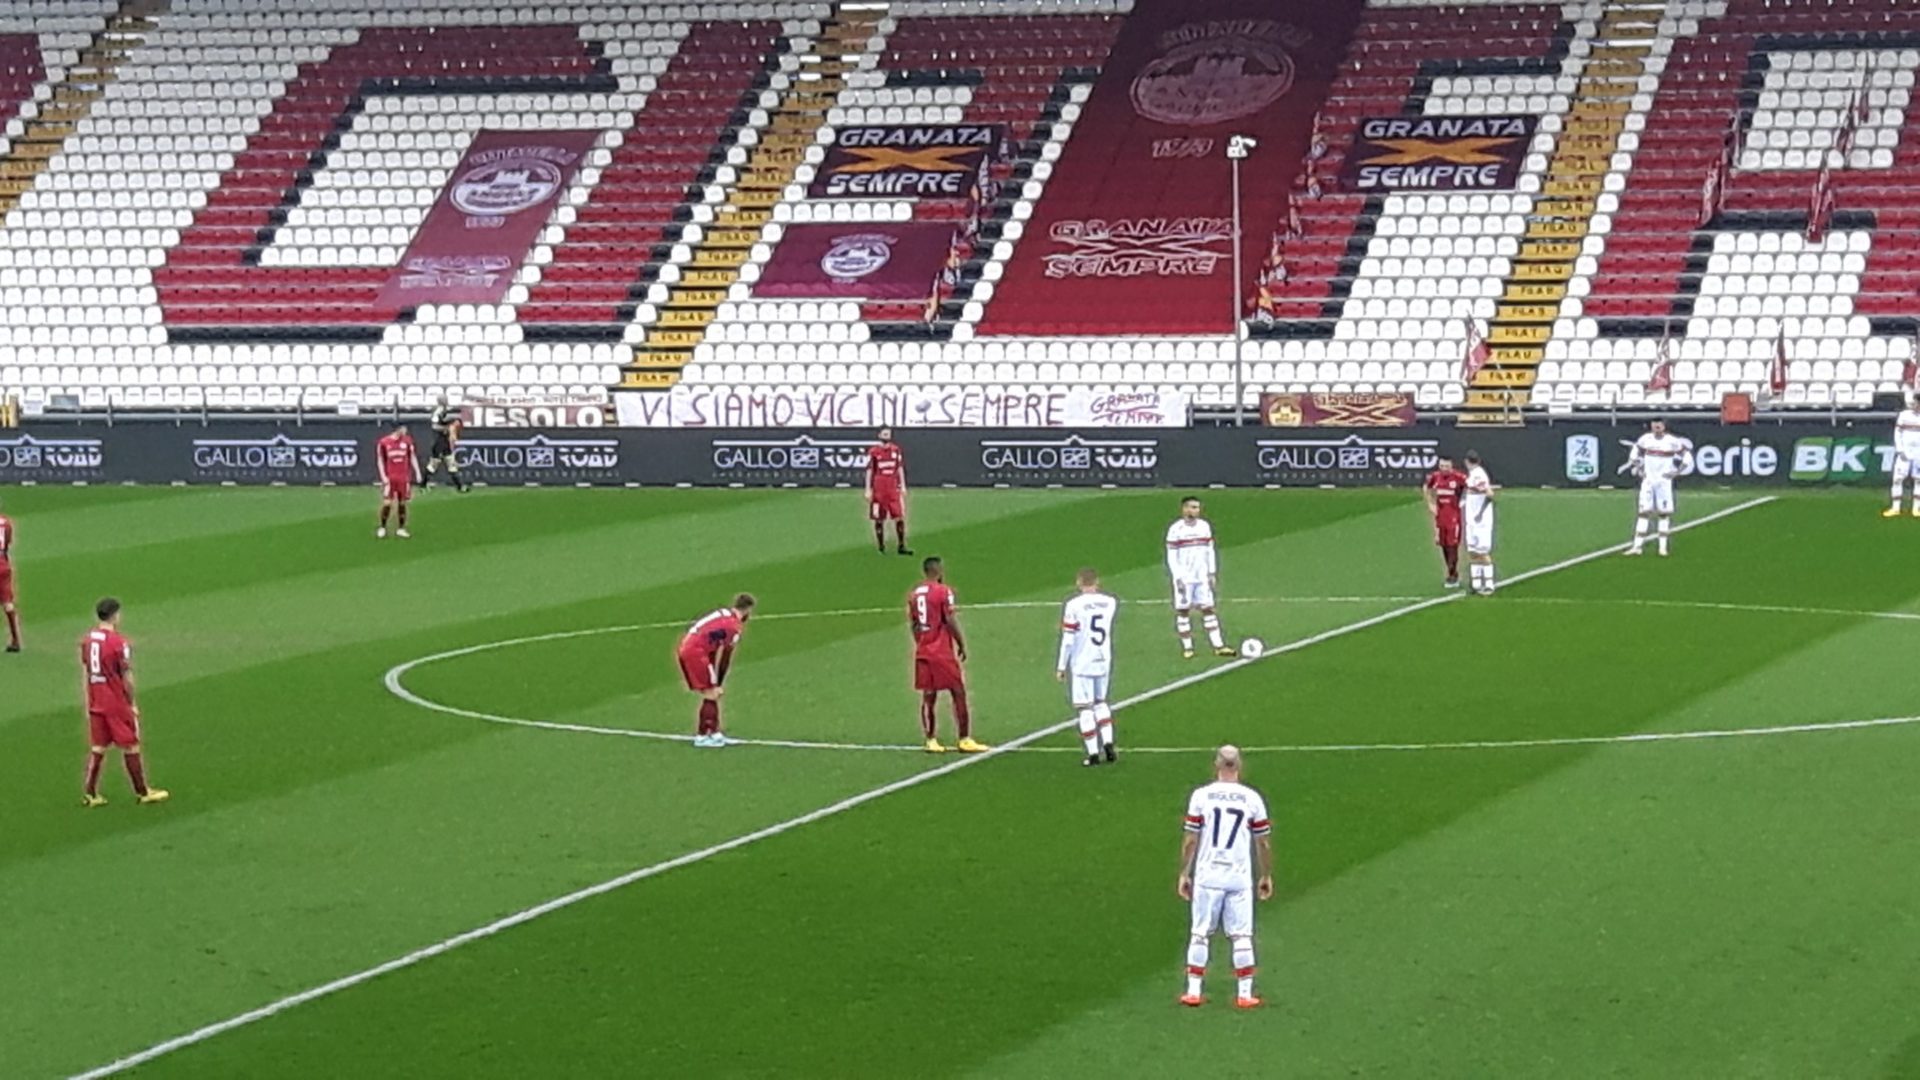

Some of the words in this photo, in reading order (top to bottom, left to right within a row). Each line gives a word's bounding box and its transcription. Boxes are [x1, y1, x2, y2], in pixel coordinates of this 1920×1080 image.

[839, 128, 991, 146] GRANATA
[1364, 119, 1525, 137] GRANATA
[827, 172, 963, 194] SEMPRE
[1358, 165, 1500, 187] SEMPRE
[1050, 218, 1238, 239] GRANATA
[1045, 257, 1216, 278] SEMPRE
[463, 406, 603, 428] JESOLO
[641, 393, 673, 425] VI
[683, 393, 794, 425] SIAMO
[806, 393, 907, 425] VICINI
[930, 393, 1066, 425] SEMPRE
[46, 447, 102, 467] ROAD
[194, 448, 264, 467] GALLO
[301, 447, 358, 467] ROAD
[455, 448, 523, 467] GALLO
[560, 447, 618, 467] ROAD
[714, 448, 787, 468] GALLO
[824, 448, 870, 467] ROA
[982, 448, 1058, 468] GALLO
[1095, 448, 1157, 468] ROAD
[1258, 448, 1335, 468] GALLO
[1374, 448, 1438, 468] ROAD
[1794, 445, 1896, 473] BKT
[917, 596, 928, 625] 9
[1090, 614, 1106, 646] 5
[91, 641, 100, 674] 8
[1213, 807, 1245, 849] 17
